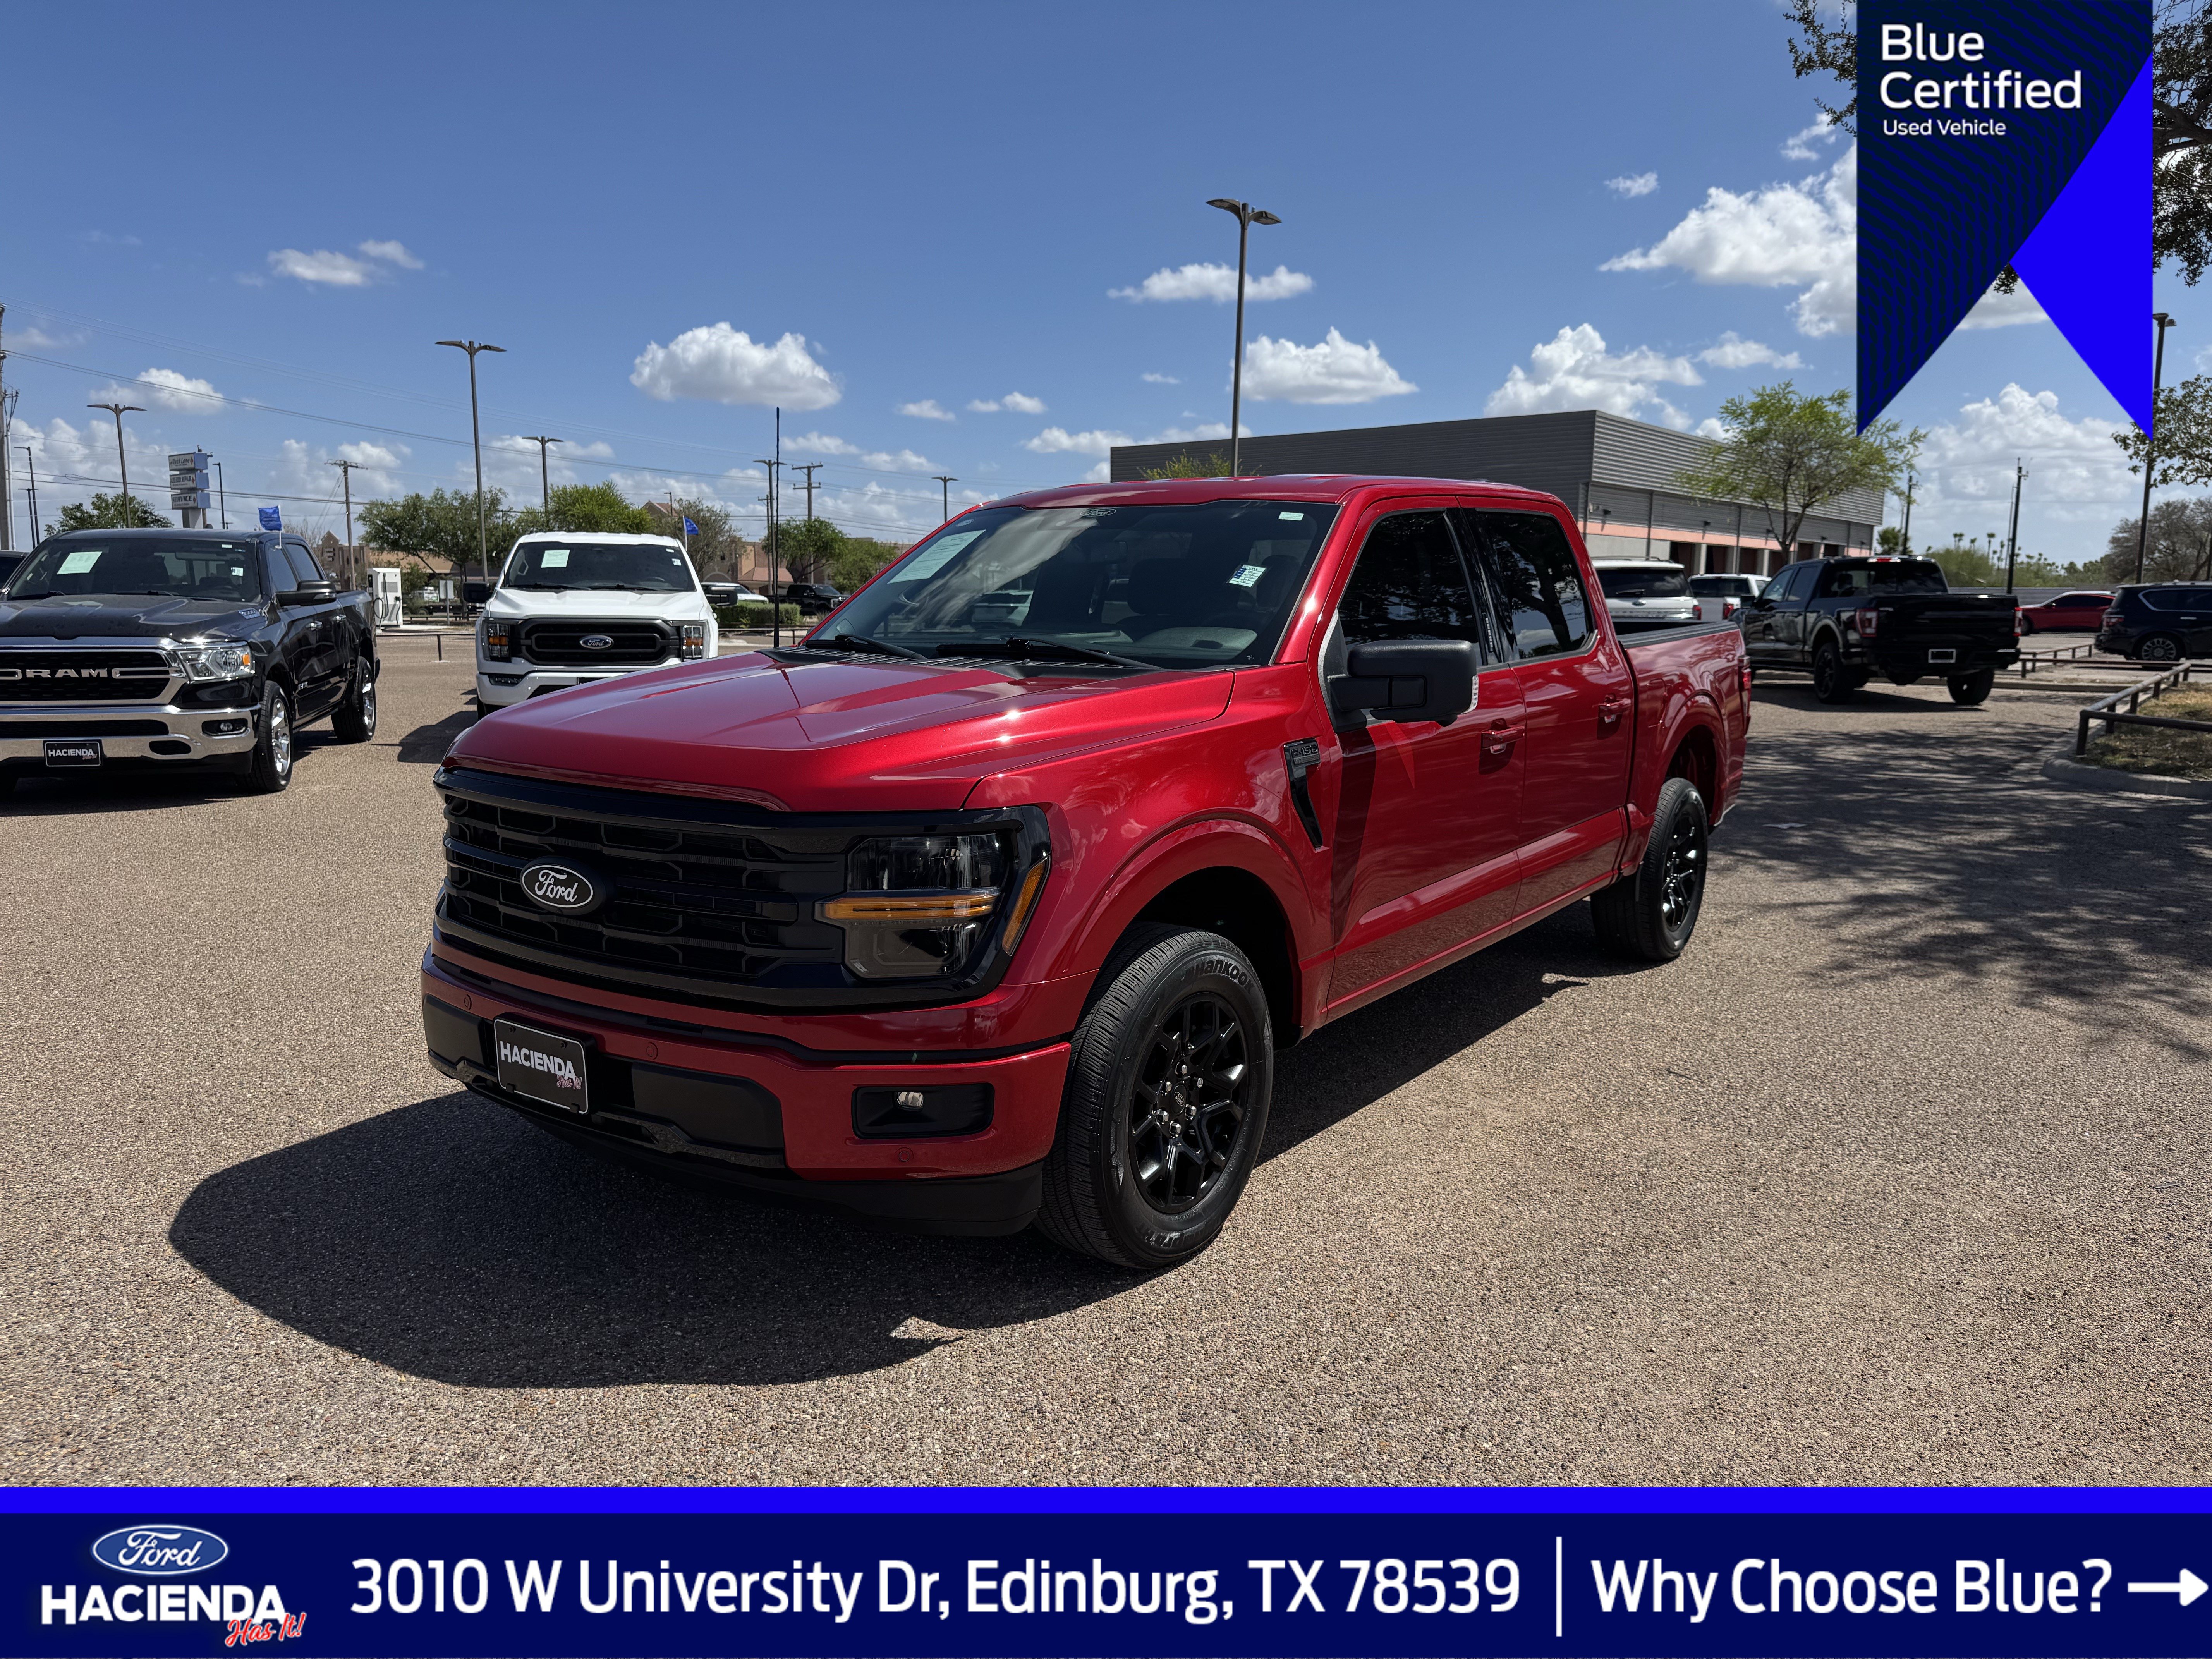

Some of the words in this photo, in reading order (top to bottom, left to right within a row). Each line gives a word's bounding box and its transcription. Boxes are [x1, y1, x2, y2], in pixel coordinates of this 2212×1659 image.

[25, 668, 108, 678] RAM
[48, 749, 94, 757] HACIENDA
[535, 870, 579, 902] Ford
[500, 1041, 576, 1082] HACIENDA
[556, 1074, 573, 1088] Has
